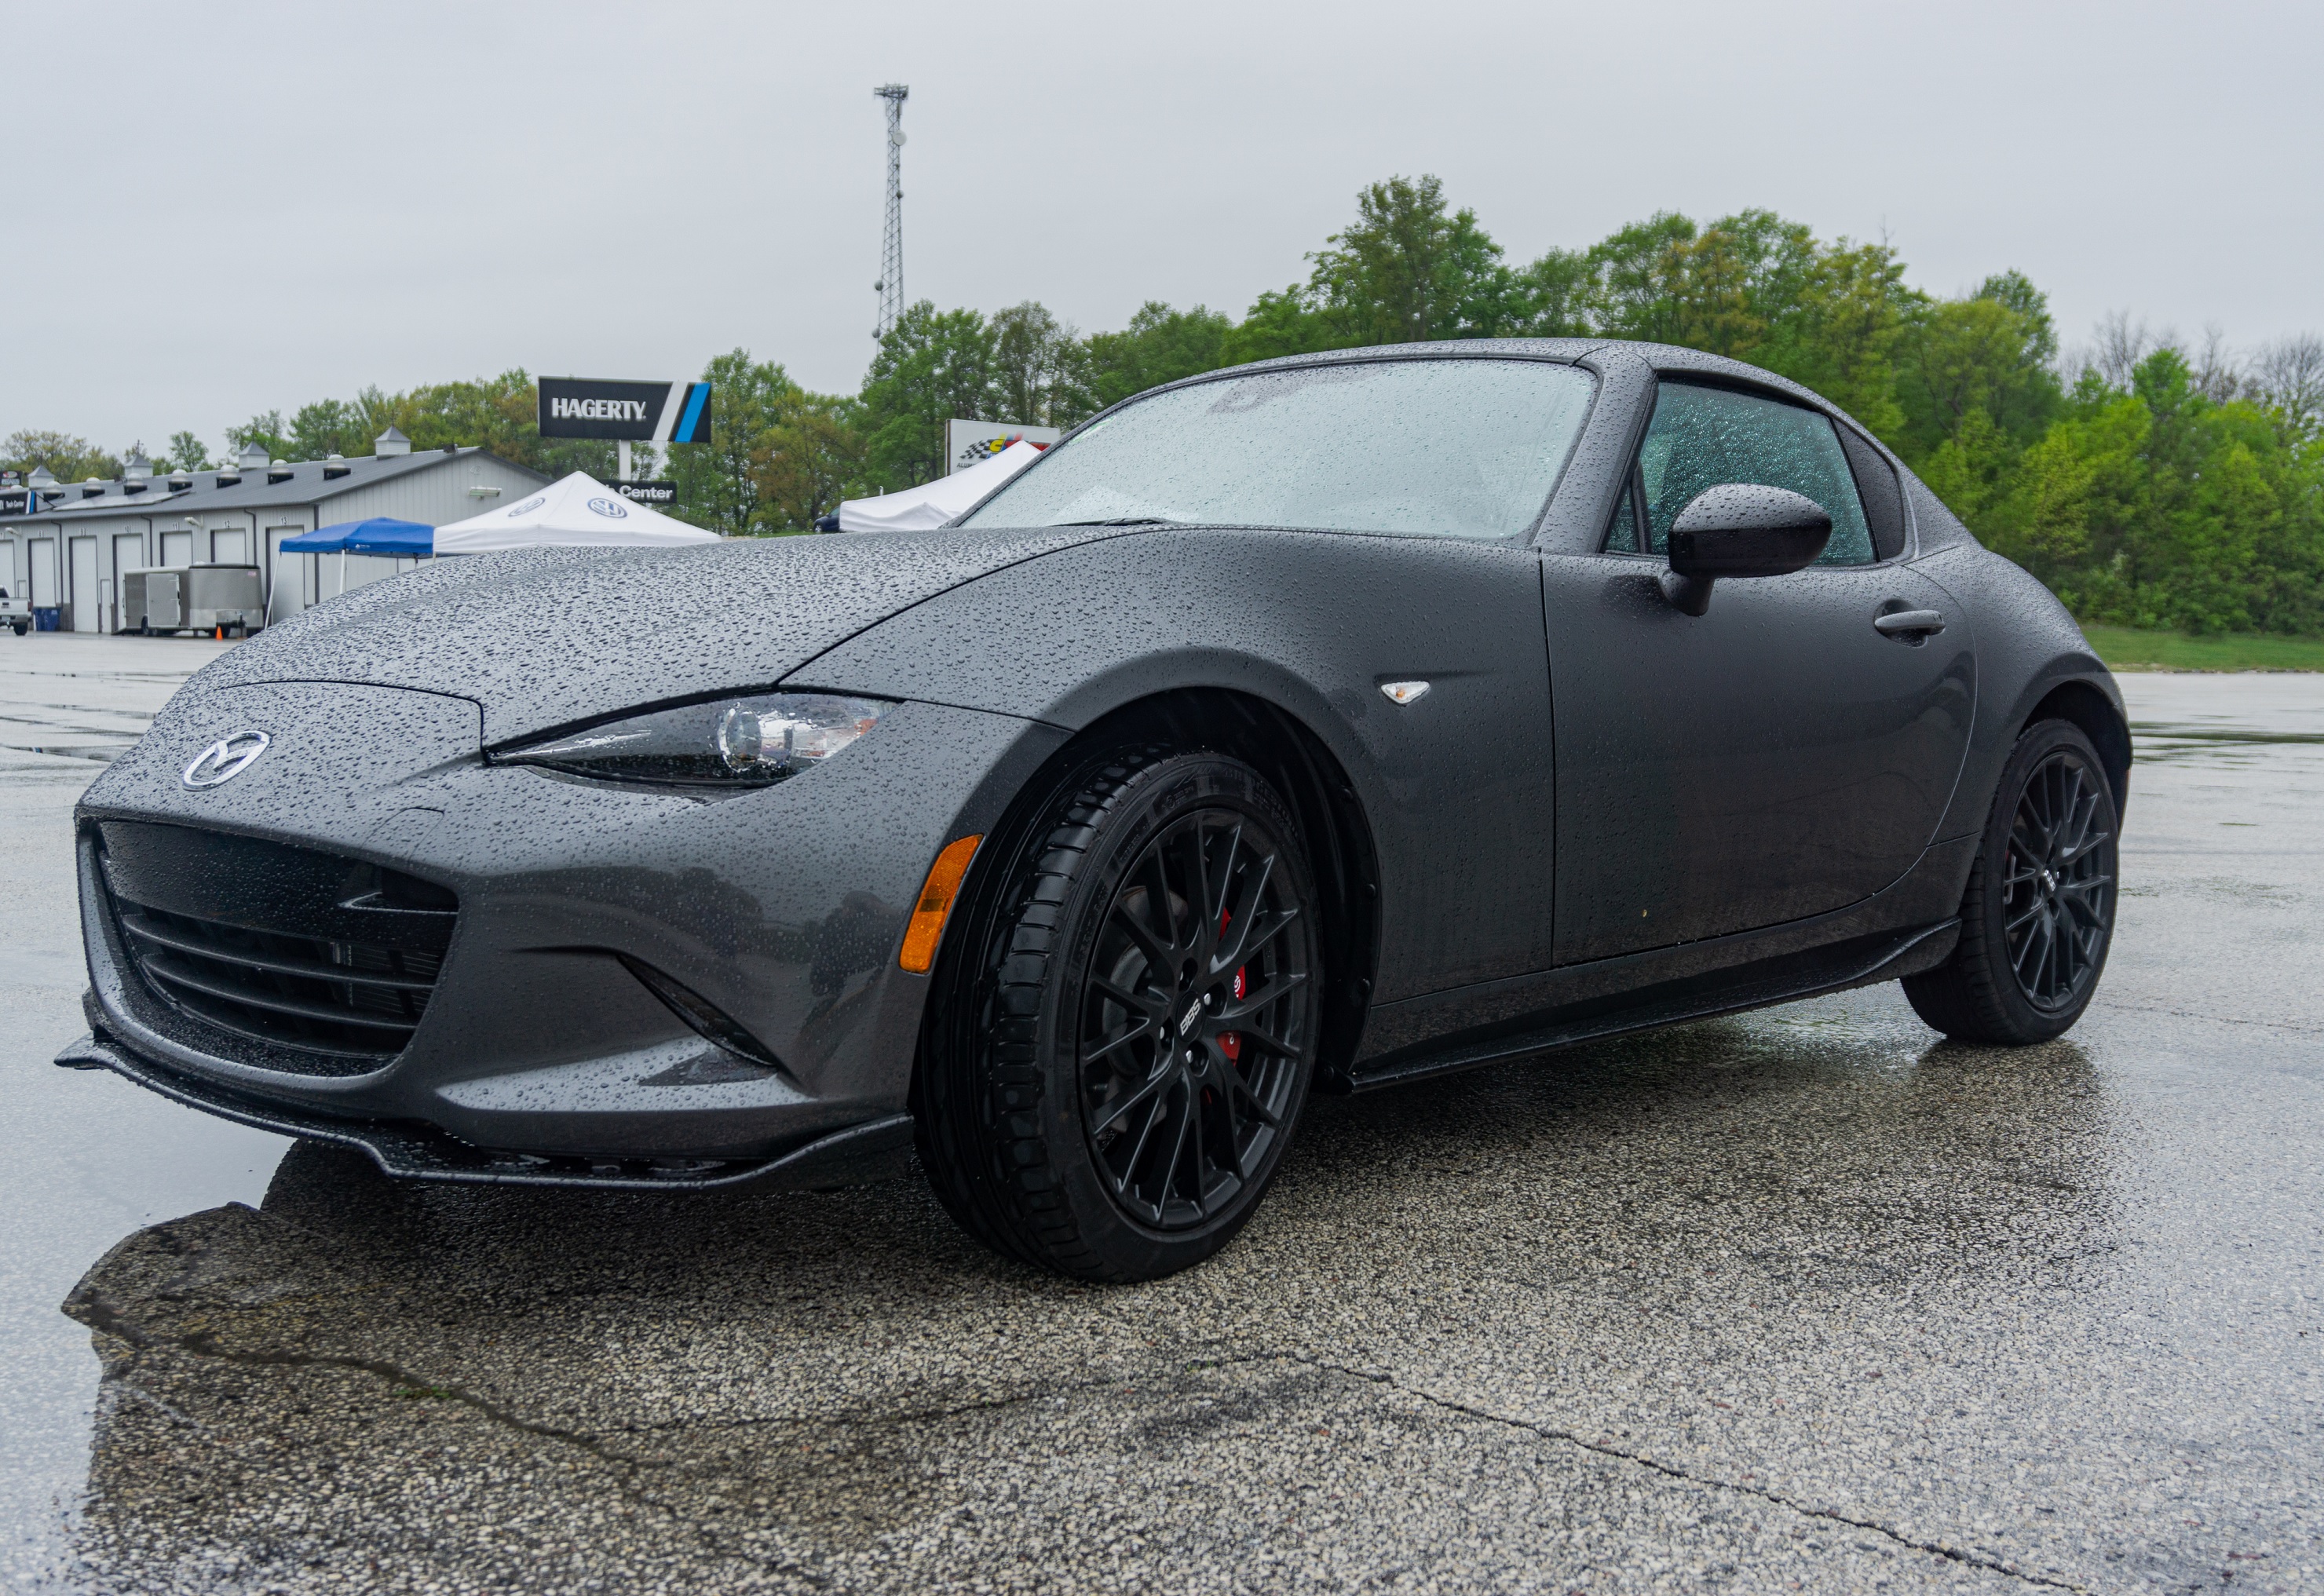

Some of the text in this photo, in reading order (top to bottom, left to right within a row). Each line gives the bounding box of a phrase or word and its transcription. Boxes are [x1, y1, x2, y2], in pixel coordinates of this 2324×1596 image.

[552, 397, 646, 420] HAGERTY
[619, 484, 673, 499] Center
[1180, 998, 1201, 1036] BBS
